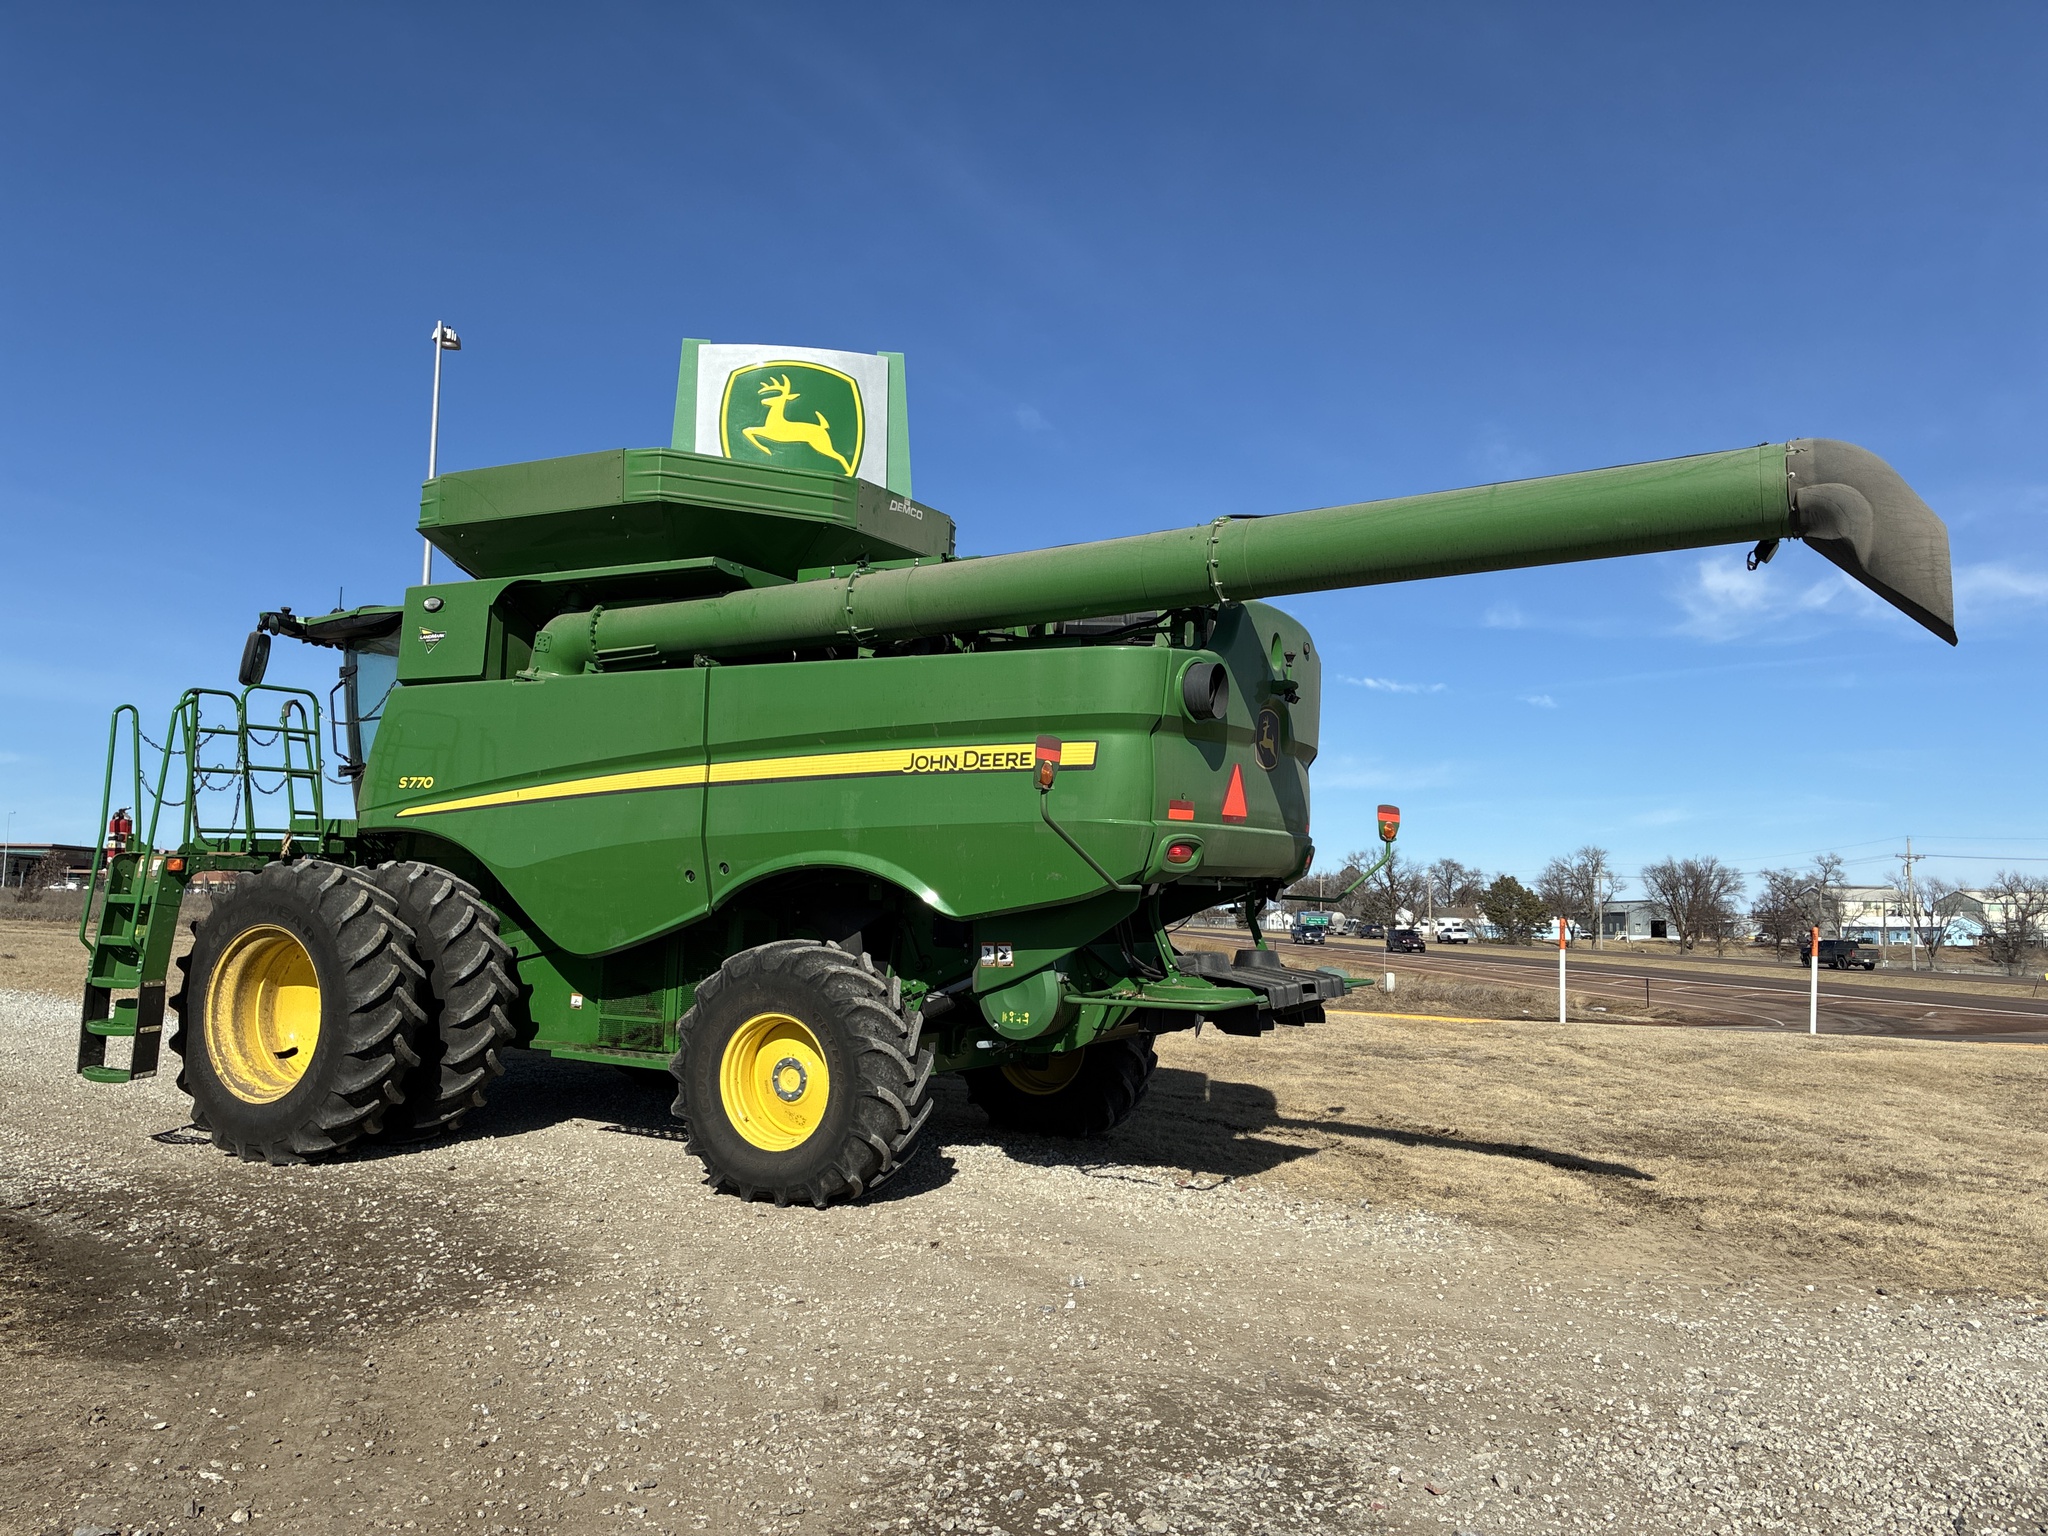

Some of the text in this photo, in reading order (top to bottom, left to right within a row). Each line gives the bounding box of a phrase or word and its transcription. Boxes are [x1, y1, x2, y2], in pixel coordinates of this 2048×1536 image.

[889, 499, 924, 521] DEMCO
[903, 750, 1032, 771] JOHN DEERE
[398, 776, 434, 789] S770
[208, 901, 316, 949] GOODYEAR
